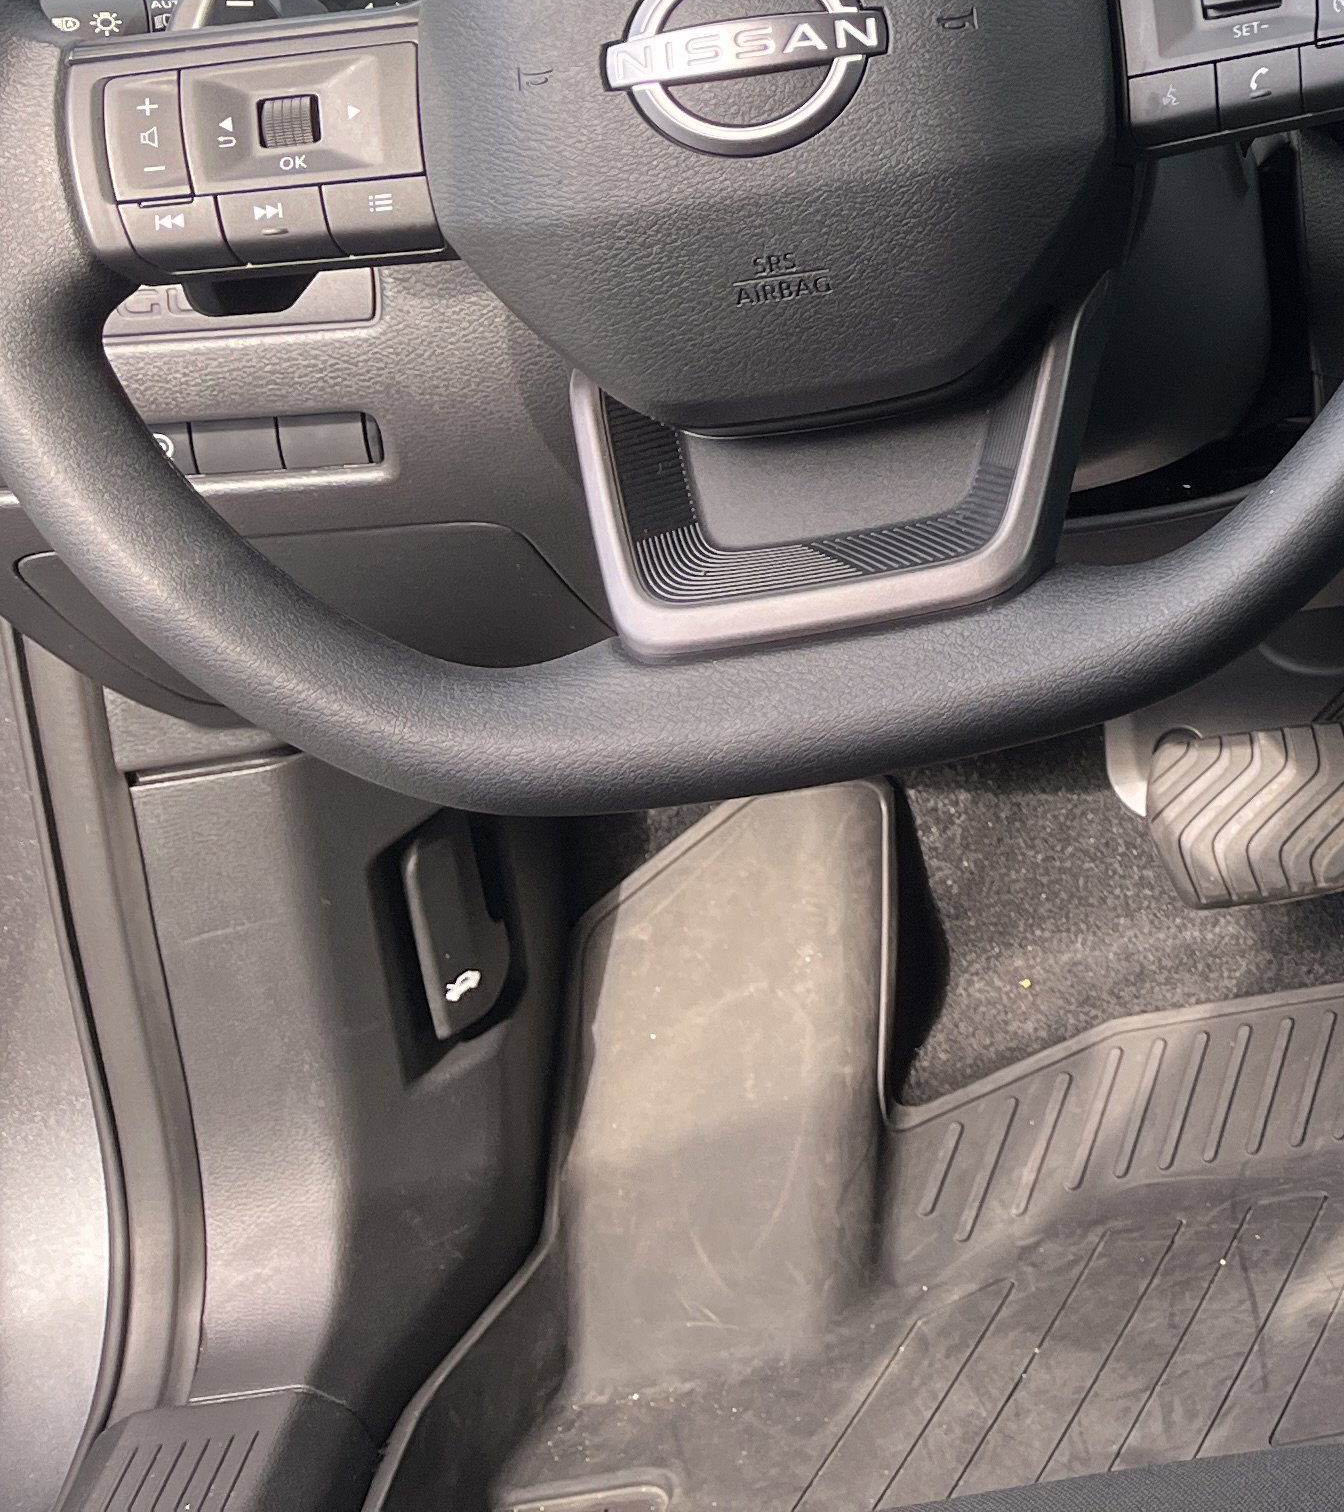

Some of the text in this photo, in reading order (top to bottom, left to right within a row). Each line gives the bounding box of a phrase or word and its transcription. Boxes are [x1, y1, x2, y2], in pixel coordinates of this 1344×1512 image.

[151, 0, 179, 10] AUT
[1232, 22, 1269, 38] SET-
[613, 16, 879, 82] NISSAN
[280, 154, 308, 170] OK
[752, 252, 797, 275] SRS
[735, 276, 832, 309] AIRBAG
